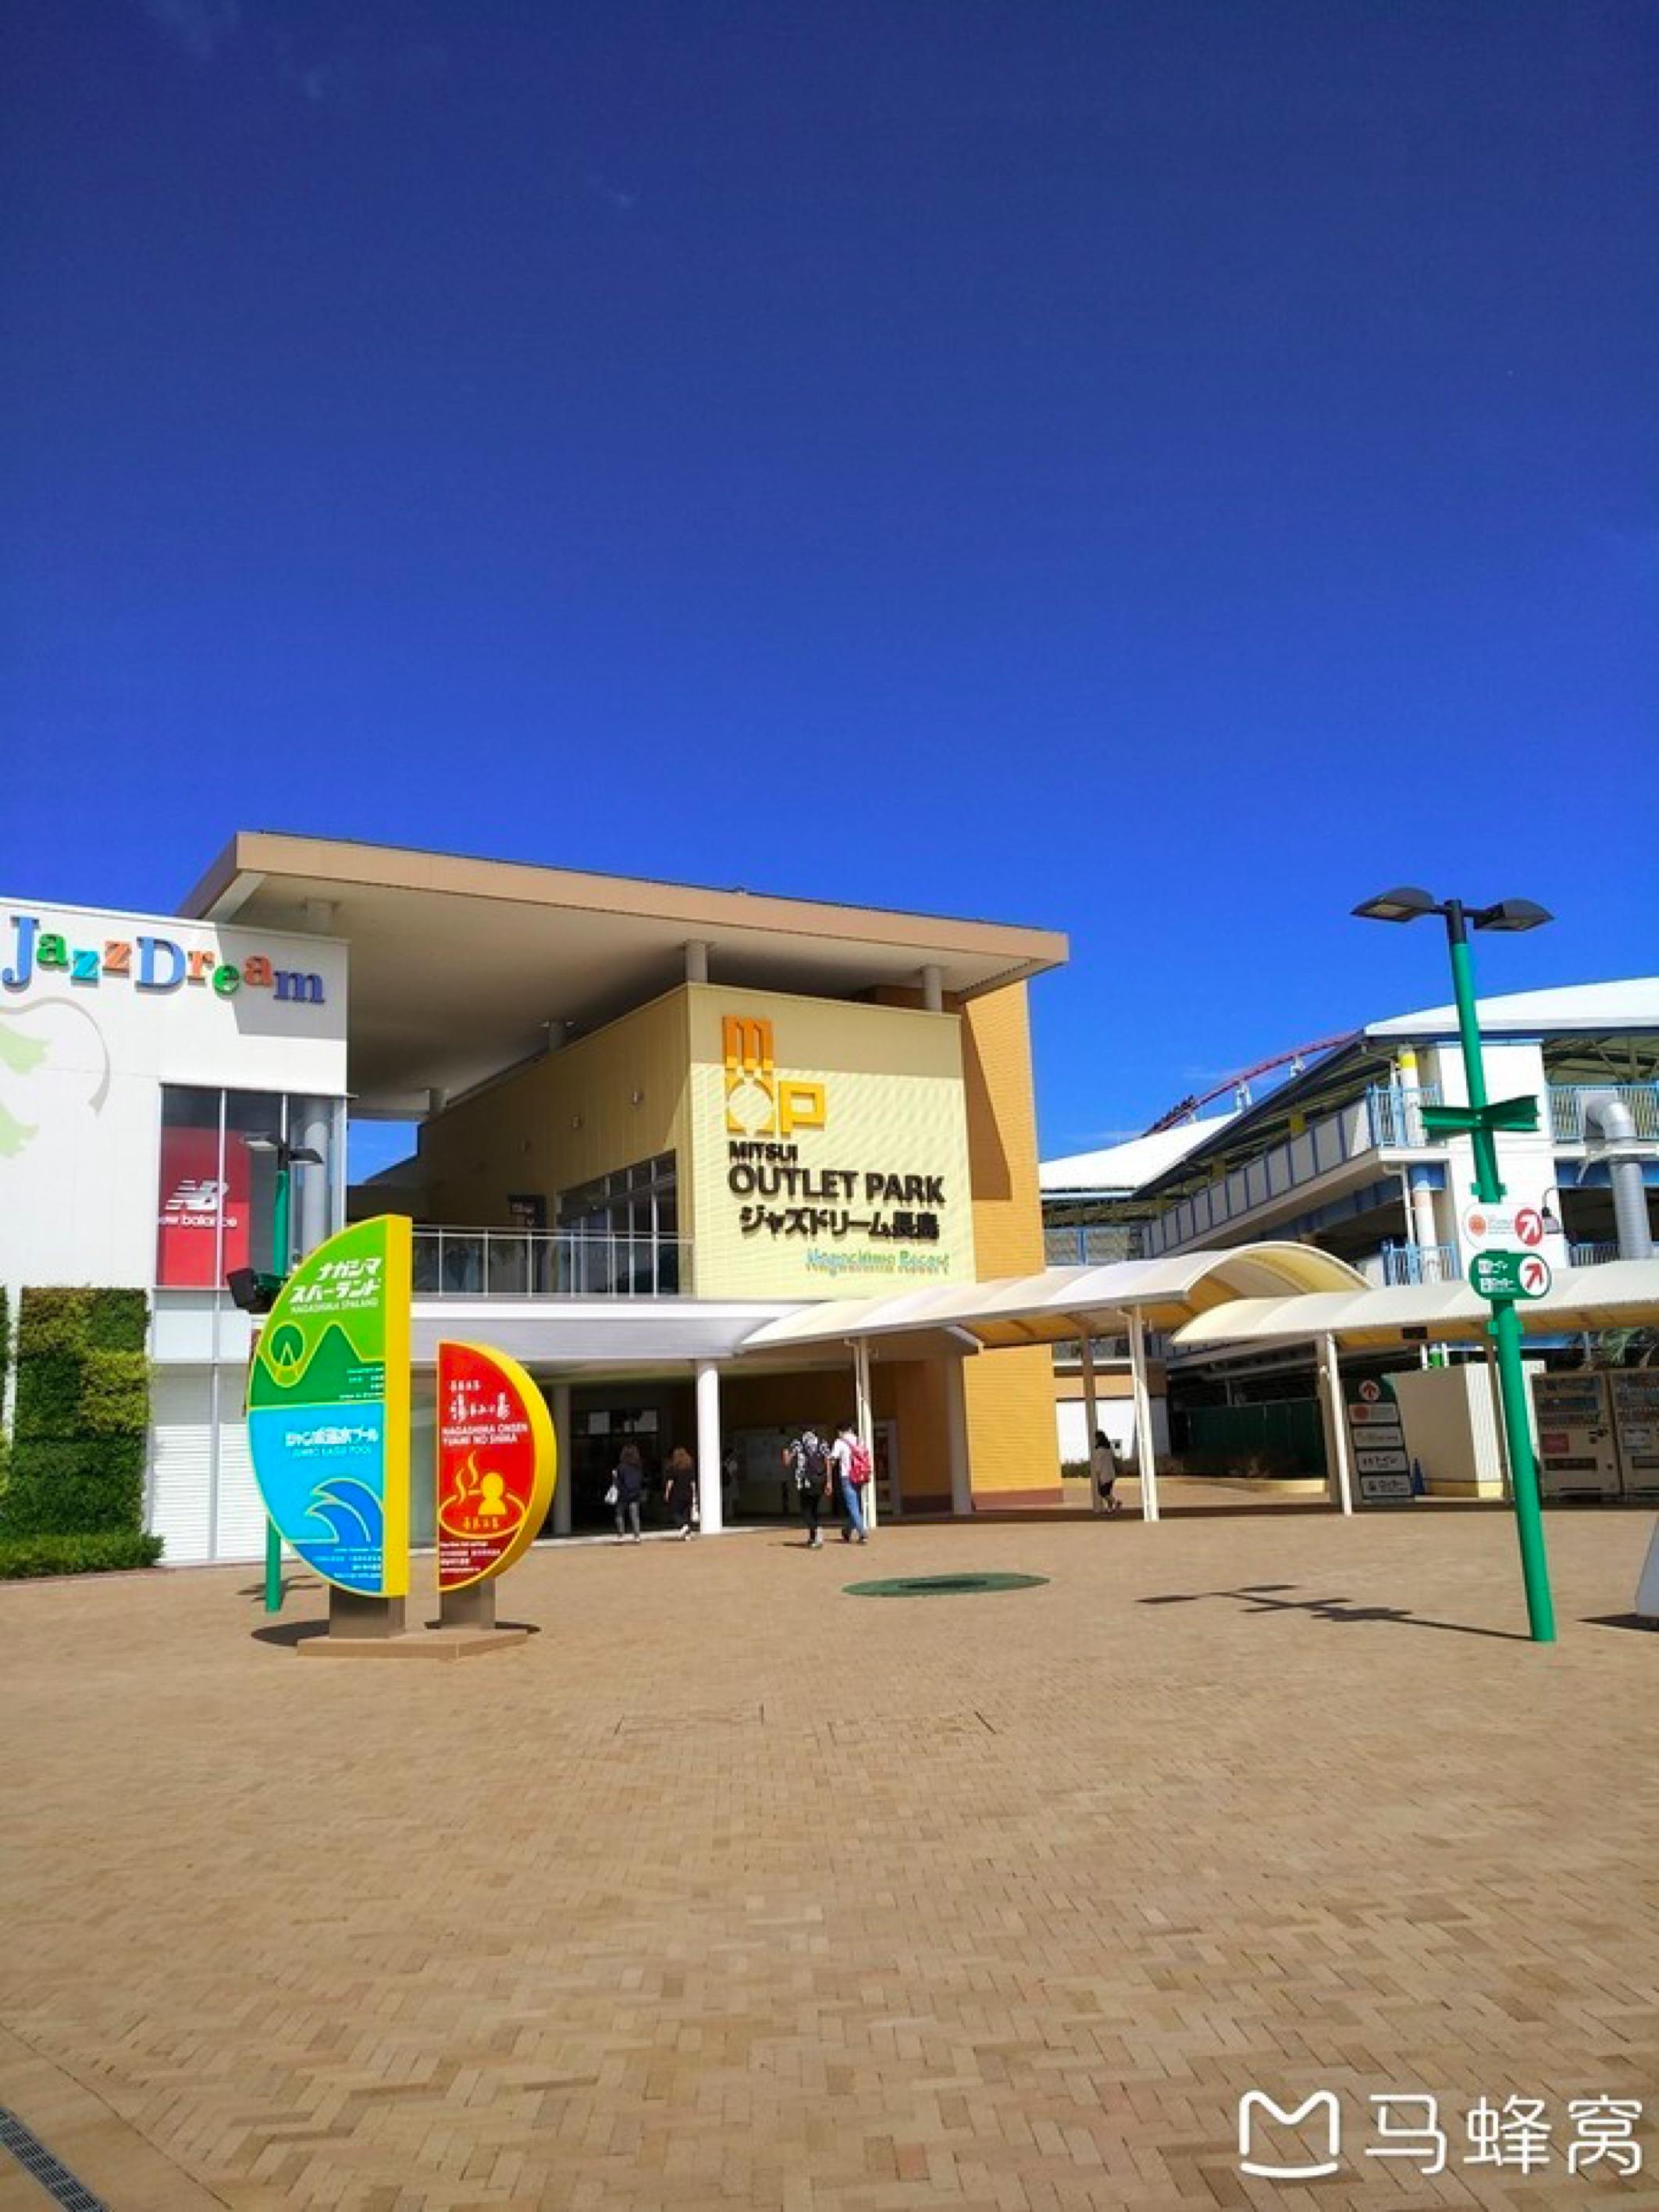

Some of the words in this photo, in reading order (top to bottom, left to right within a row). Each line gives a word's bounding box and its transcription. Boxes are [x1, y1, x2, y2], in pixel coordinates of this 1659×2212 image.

[729, 1142, 798, 1162] MITSUI
[728, 1164, 859, 1198] OUTLET
[865, 1173, 945, 1203] PARK
[316, 1258, 382, 1281] ナガシマ
